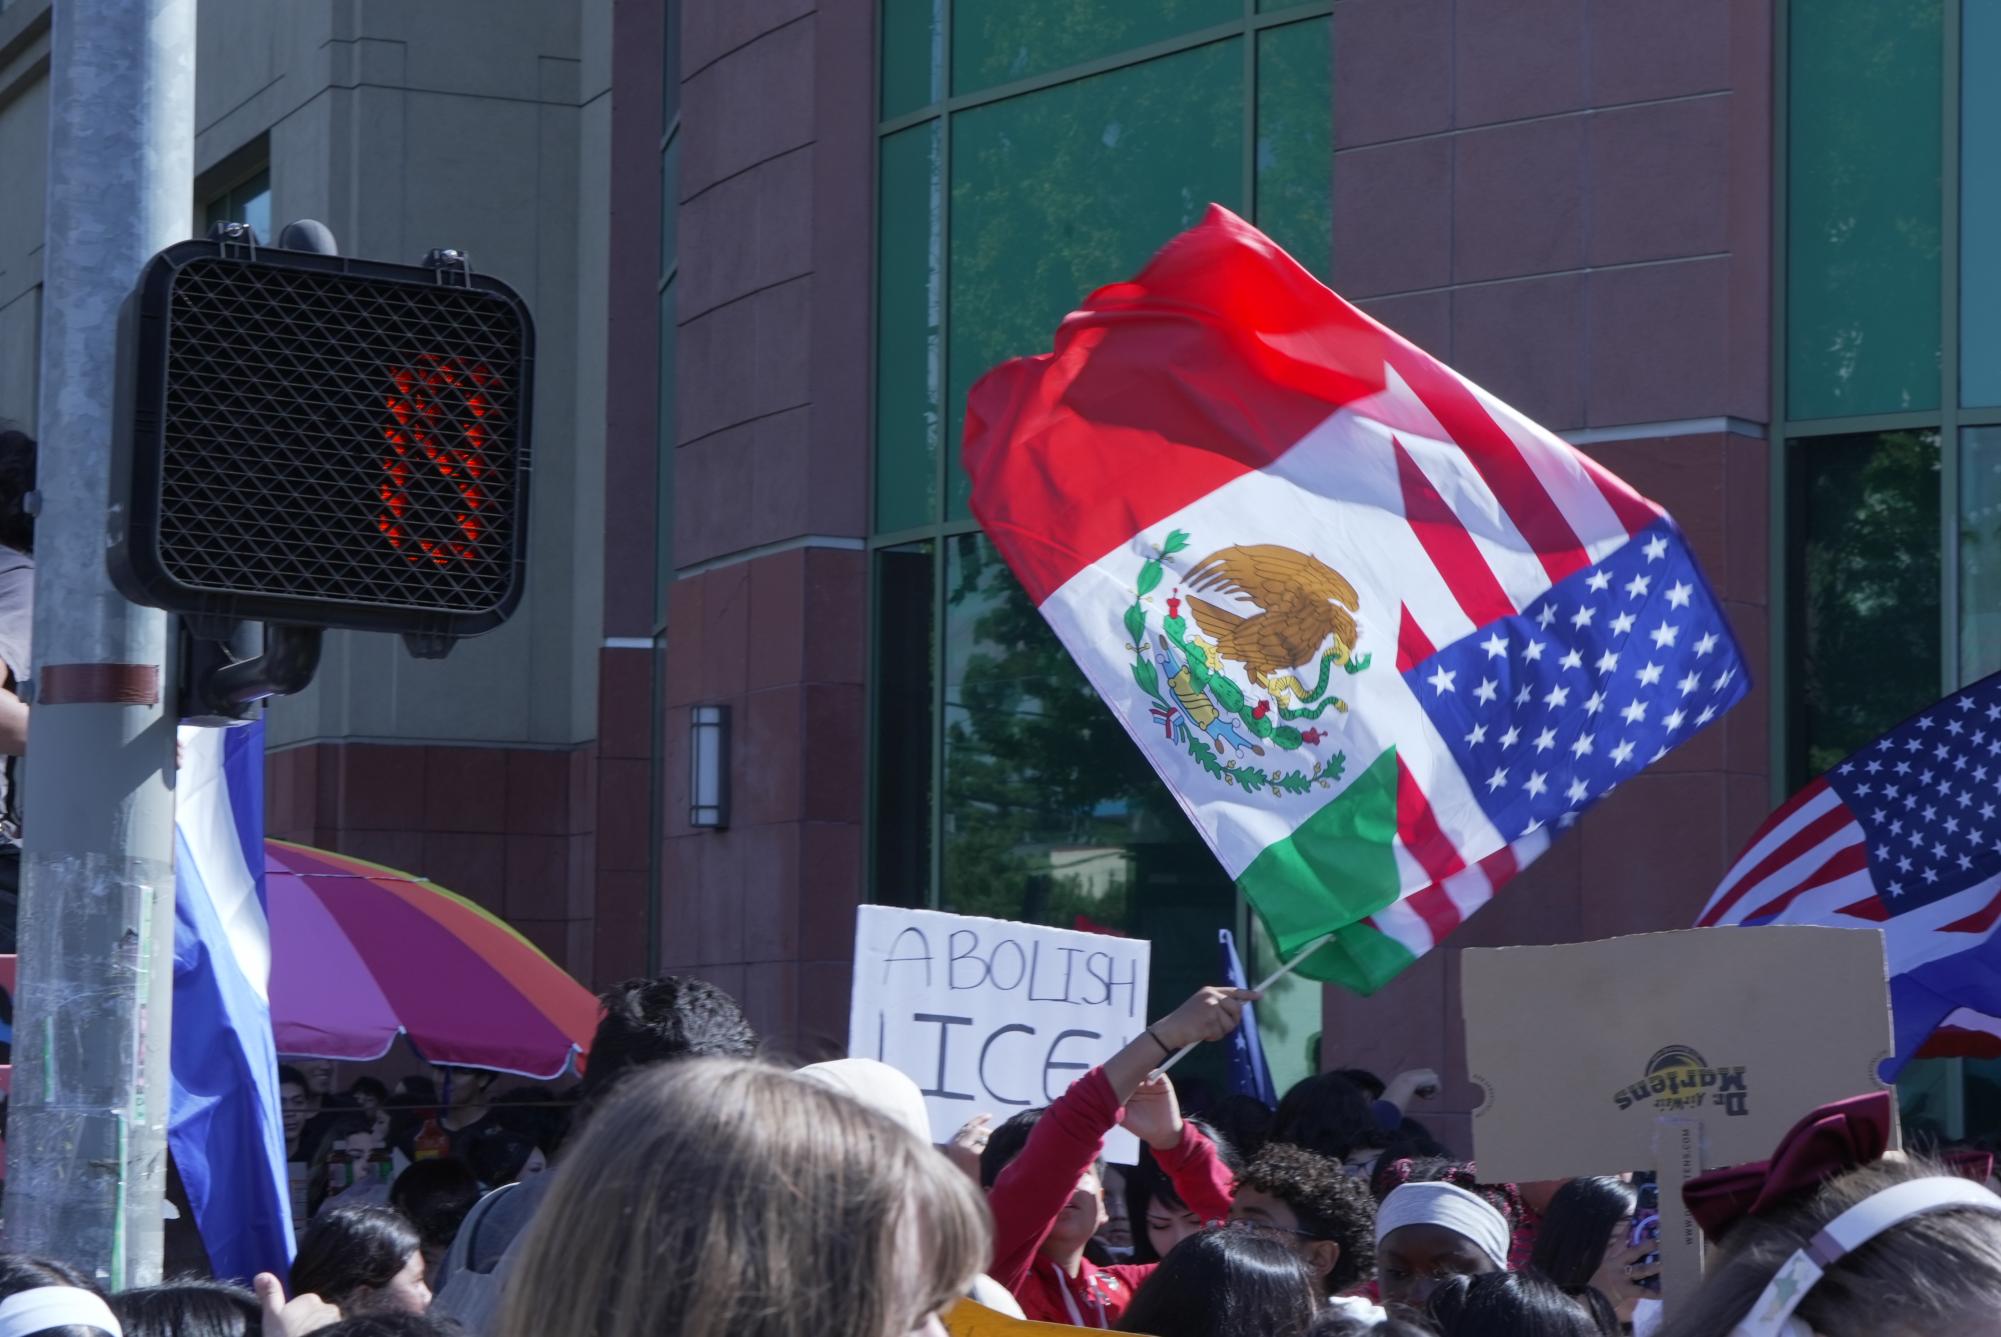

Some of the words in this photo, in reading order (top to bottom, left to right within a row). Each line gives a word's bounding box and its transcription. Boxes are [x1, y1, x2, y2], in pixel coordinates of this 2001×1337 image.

[883, 926, 1137, 1018] ABOLISH
[912, 1012, 1103, 1106] ICE
[1613, 1066, 1747, 1111] Martens
